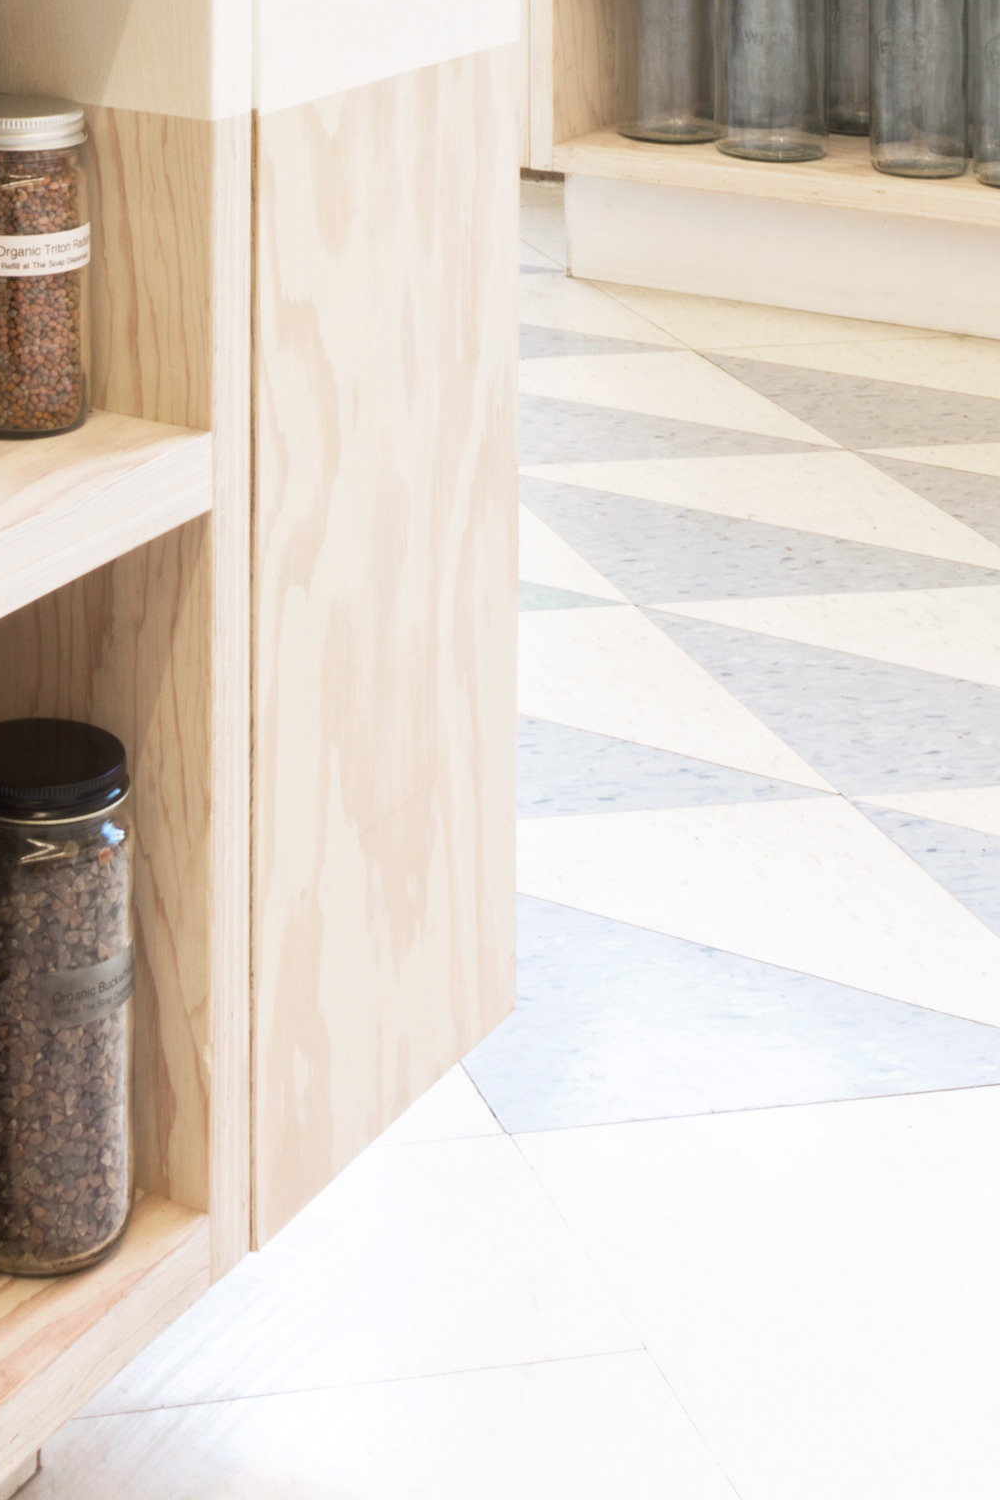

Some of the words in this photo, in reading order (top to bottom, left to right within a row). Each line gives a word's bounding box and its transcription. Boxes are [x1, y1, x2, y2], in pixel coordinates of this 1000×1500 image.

[45, 243, 71, 255] Triton
[1, 262, 20, 270] Refill
[52, 987, 95, 1005] Organic
